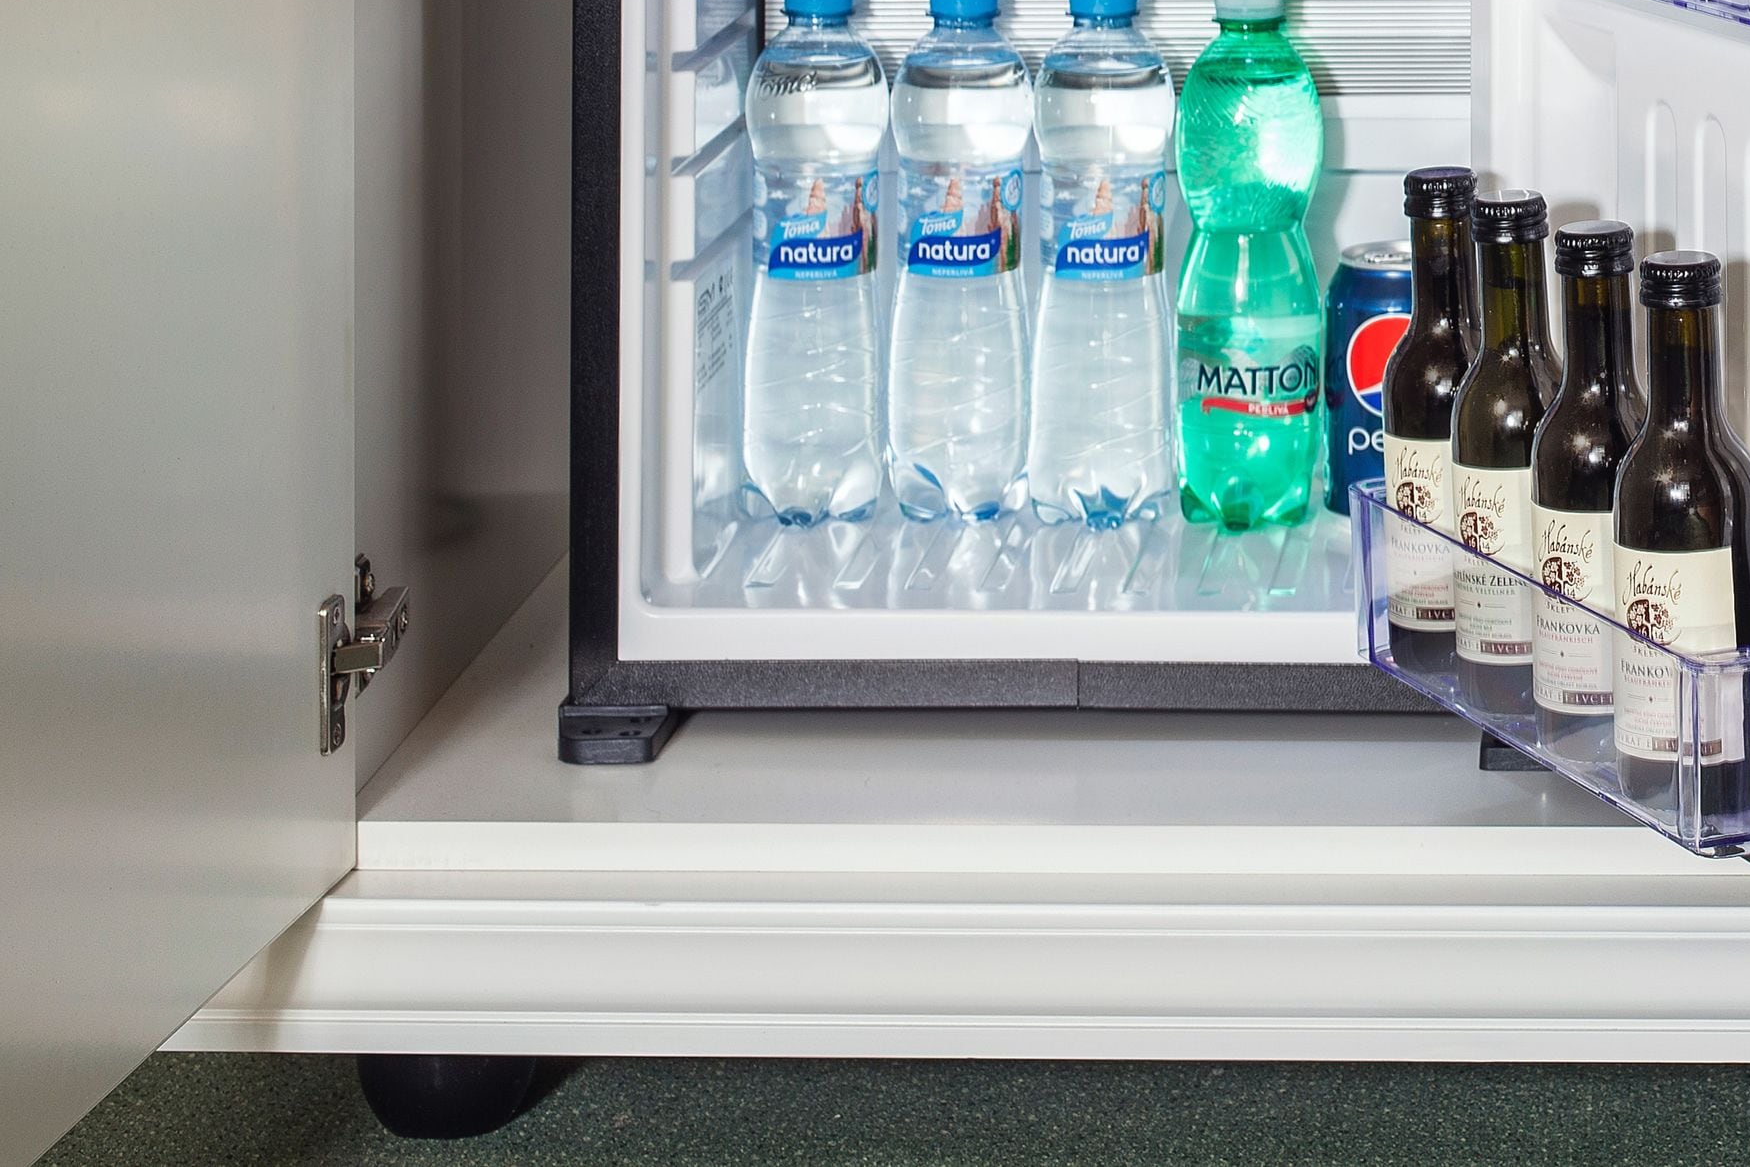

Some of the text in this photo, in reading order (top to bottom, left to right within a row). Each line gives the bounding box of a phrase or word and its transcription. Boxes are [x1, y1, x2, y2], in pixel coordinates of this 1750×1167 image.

[780, 218, 820, 240] Toma
[919, 216, 957, 236] Toma
[1067, 218, 1106, 240] Toma
[780, 242, 853, 263] natura
[918, 240, 991, 261] natura
[1067, 243, 1140, 264] natura
[1457, 476, 1506, 519] Habánské
[1537, 519, 1594, 564] Habánské
[1622, 560, 1682, 606] Habánské
[1536, 615, 1600, 635] FRANKOVKA
